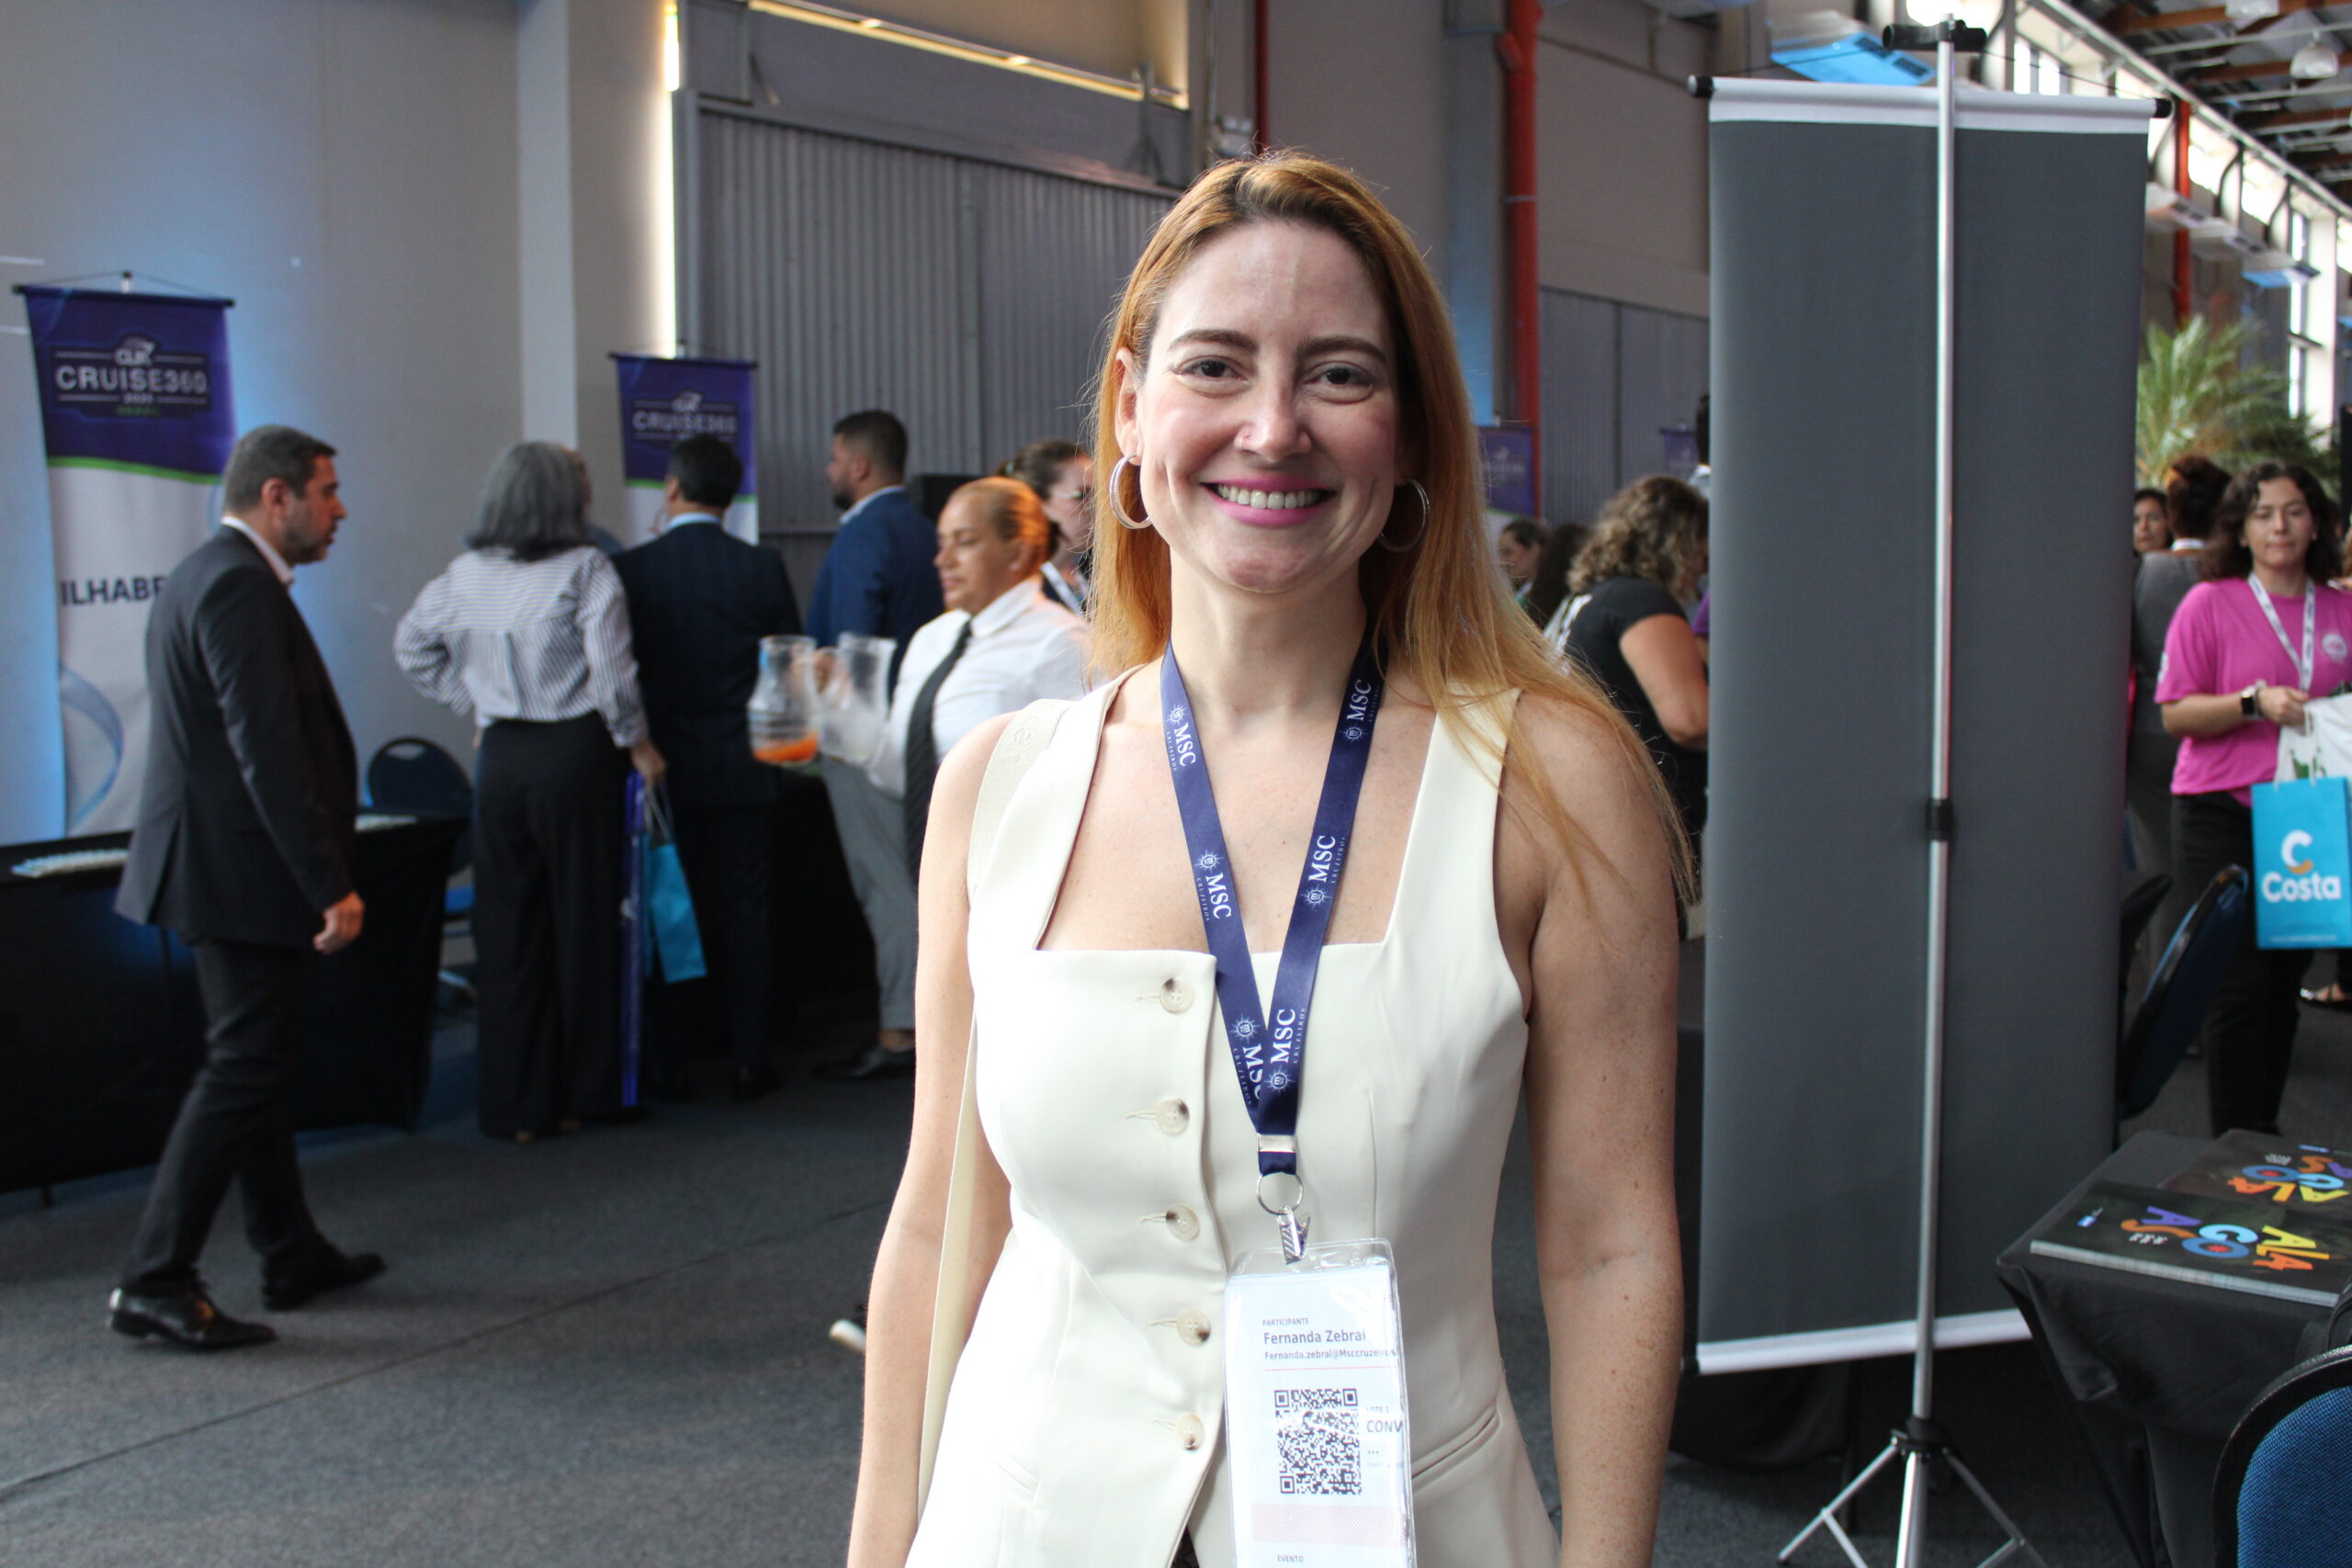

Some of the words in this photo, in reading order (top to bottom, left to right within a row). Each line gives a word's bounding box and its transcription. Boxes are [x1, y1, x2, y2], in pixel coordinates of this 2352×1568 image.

[55, 366, 208, 394] CRUISE360
[1347, 680, 1372, 721] MSC
[1174, 722, 1196, 767] MSC
[1308, 835, 1336, 883] MSC
[1205, 872, 1232, 919] MSC
[2261, 871, 2342, 903] Costa
[1271, 1009, 1296, 1064] MSC
[1262, 1317, 1309, 1326] PARTICIPANTE
[1263, 1330, 1322, 1345] Fernanda
[1366, 1419, 1403, 1433] CONV
[1277, 1554, 1305, 1563] EVENTO
